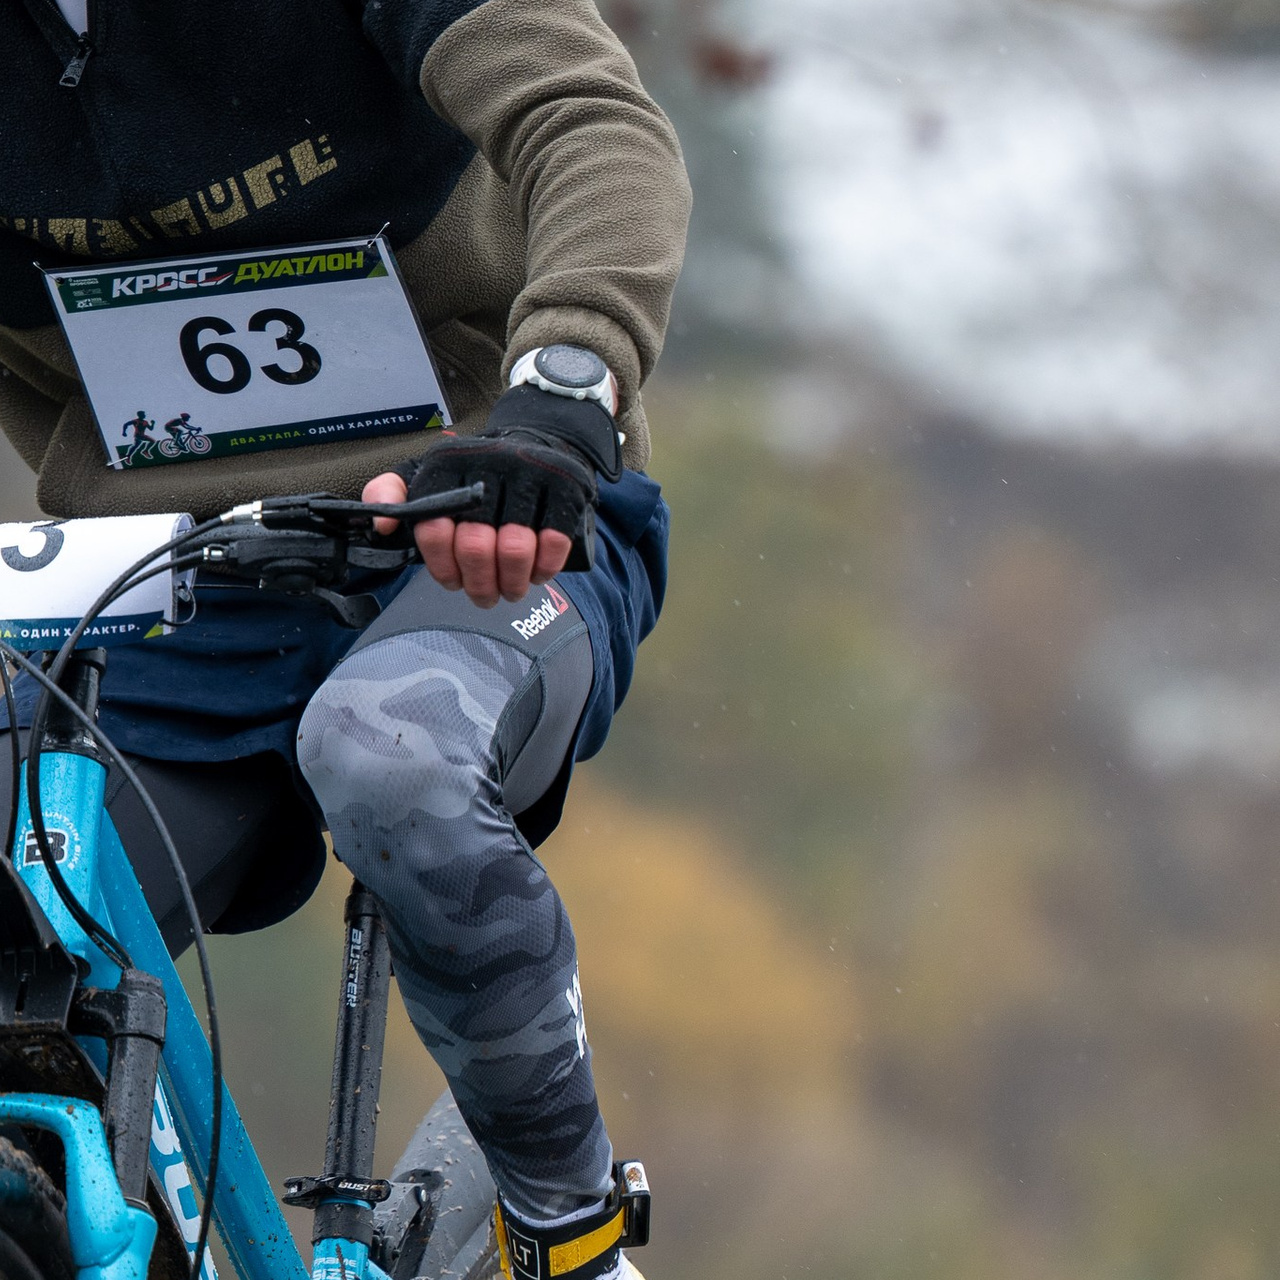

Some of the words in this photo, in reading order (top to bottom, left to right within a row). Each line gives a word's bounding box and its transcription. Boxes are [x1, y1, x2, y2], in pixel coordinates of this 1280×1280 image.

[112, 266, 222, 299] КРОСС
[233, 251, 364, 286] ДУАТЛОН
[179, 307, 323, 395] 63
[229, 436, 256, 447] ДВА
[259, 430, 306, 442] ЭТАПА.
[308, 423, 345, 435] ОДИН
[348, 414, 419, 430] ХАРАКТЕР.
[21, 627, 60, 639] ОДИН
[64, 623, 141, 637] ХРАКТЕР.
[510, 597, 560, 640] Reebok
[346, 928, 362, 1008] BUSTER
